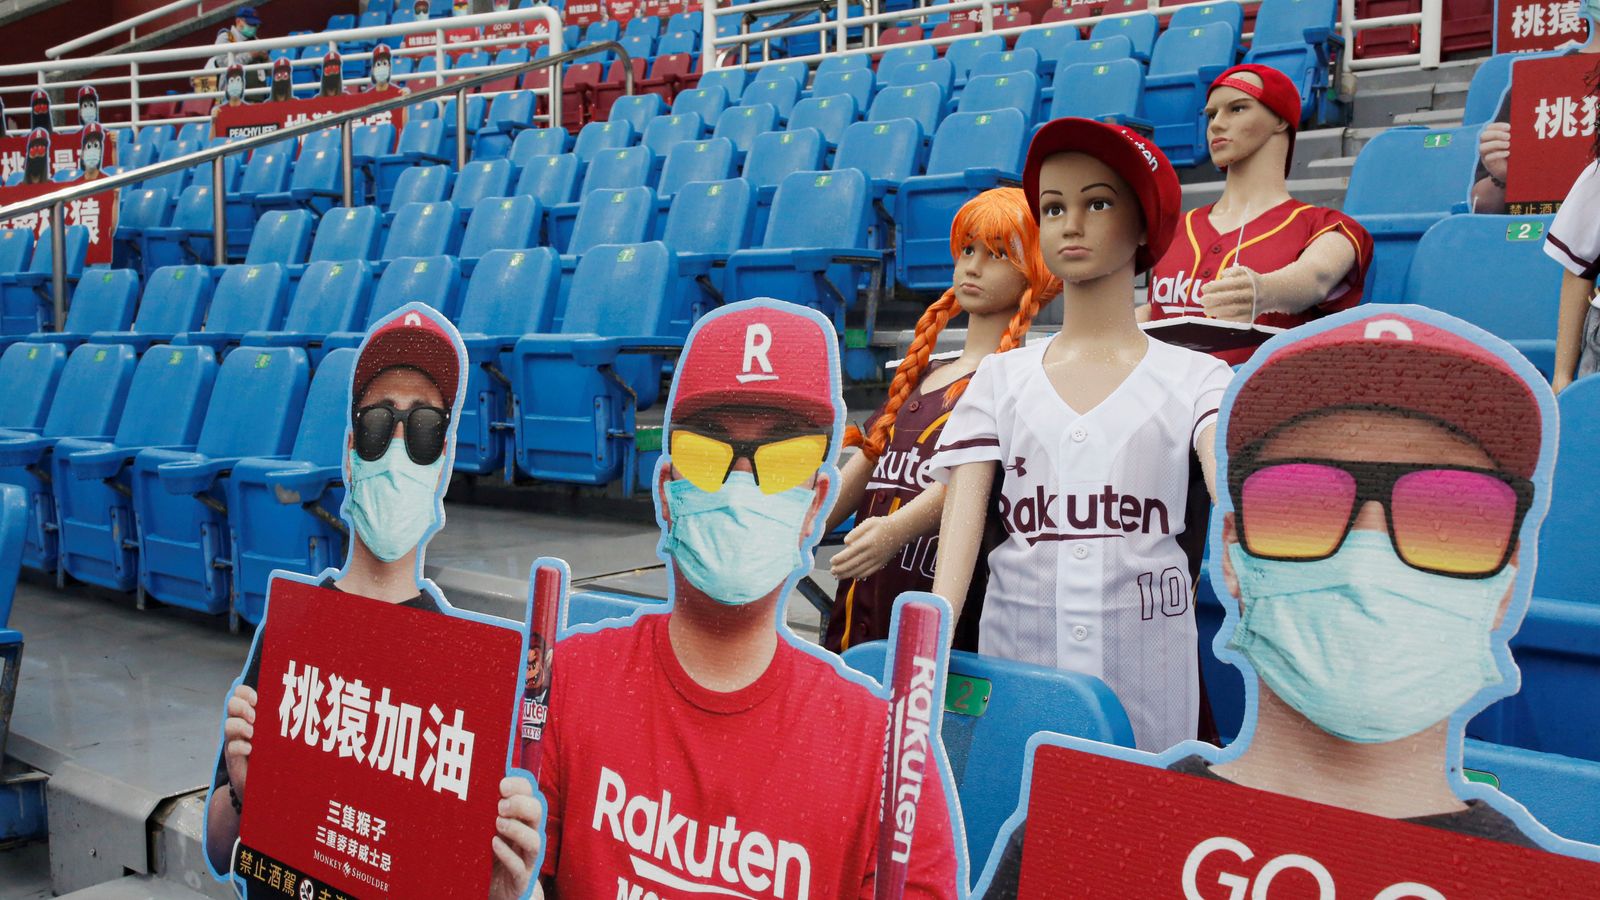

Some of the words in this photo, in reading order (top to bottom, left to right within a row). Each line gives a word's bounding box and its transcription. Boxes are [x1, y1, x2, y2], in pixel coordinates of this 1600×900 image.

[1511, 0, 1580, 38] 桃猿
[1518, 223, 1531, 239] 2
[742, 323, 773, 373] R
[998, 484, 1170, 535] Rakuten
[1137, 566, 1188, 621] 10
[957, 682, 974, 710] 2
[278, 659, 476, 802] 桃猿加油
[891, 655, 937, 864] Rakuten
[326, 800, 387, 842] 三隻猴子
[592, 765, 811, 900] Rakuten
[313, 850, 343, 871] MONKEY
[351, 867, 389, 892] SHOULDER
[315, 826, 392, 872] 三重麥芽威士忌
[239, 850, 297, 897] 禁止酒駕
